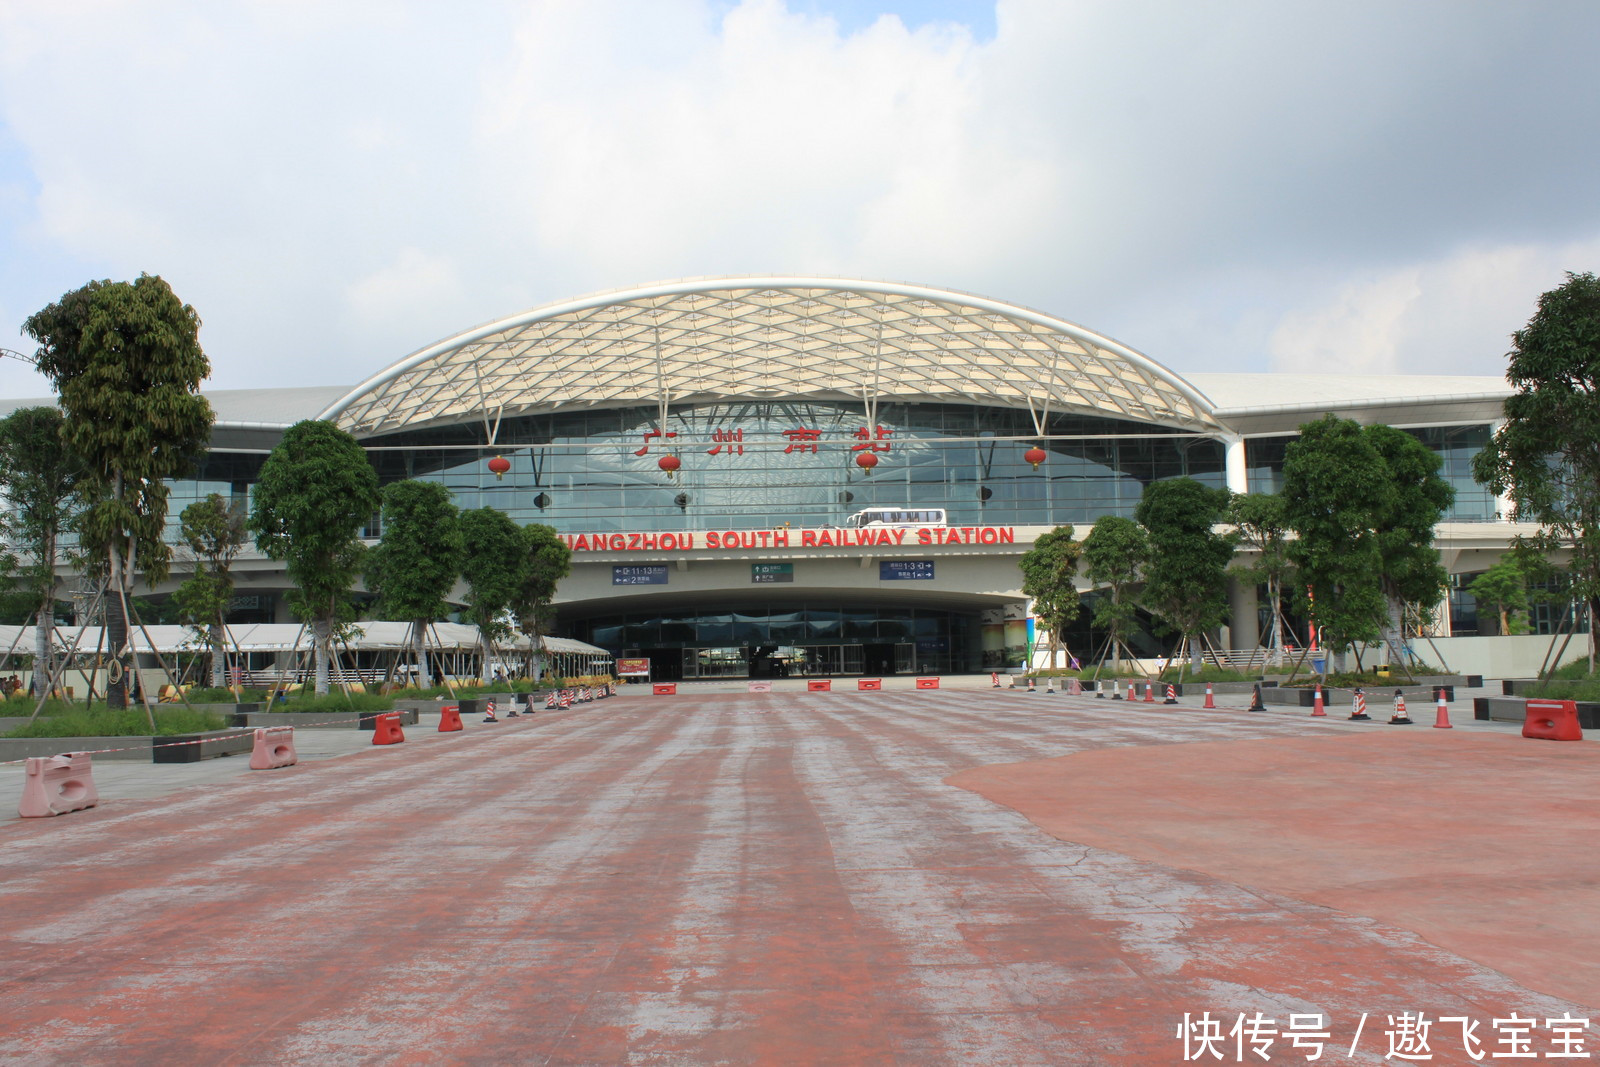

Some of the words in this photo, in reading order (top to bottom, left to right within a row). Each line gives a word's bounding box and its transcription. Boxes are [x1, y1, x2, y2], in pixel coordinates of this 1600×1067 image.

[634, 425, 894, 456] 广州南站
[558, 533, 693, 551] UANGZHOU
[706, 531, 788, 549] SOUTH
[802, 529, 905, 546] RAILWAY
[918, 527, 1014, 544] STATION
[631, 576, 637, 584] 2
